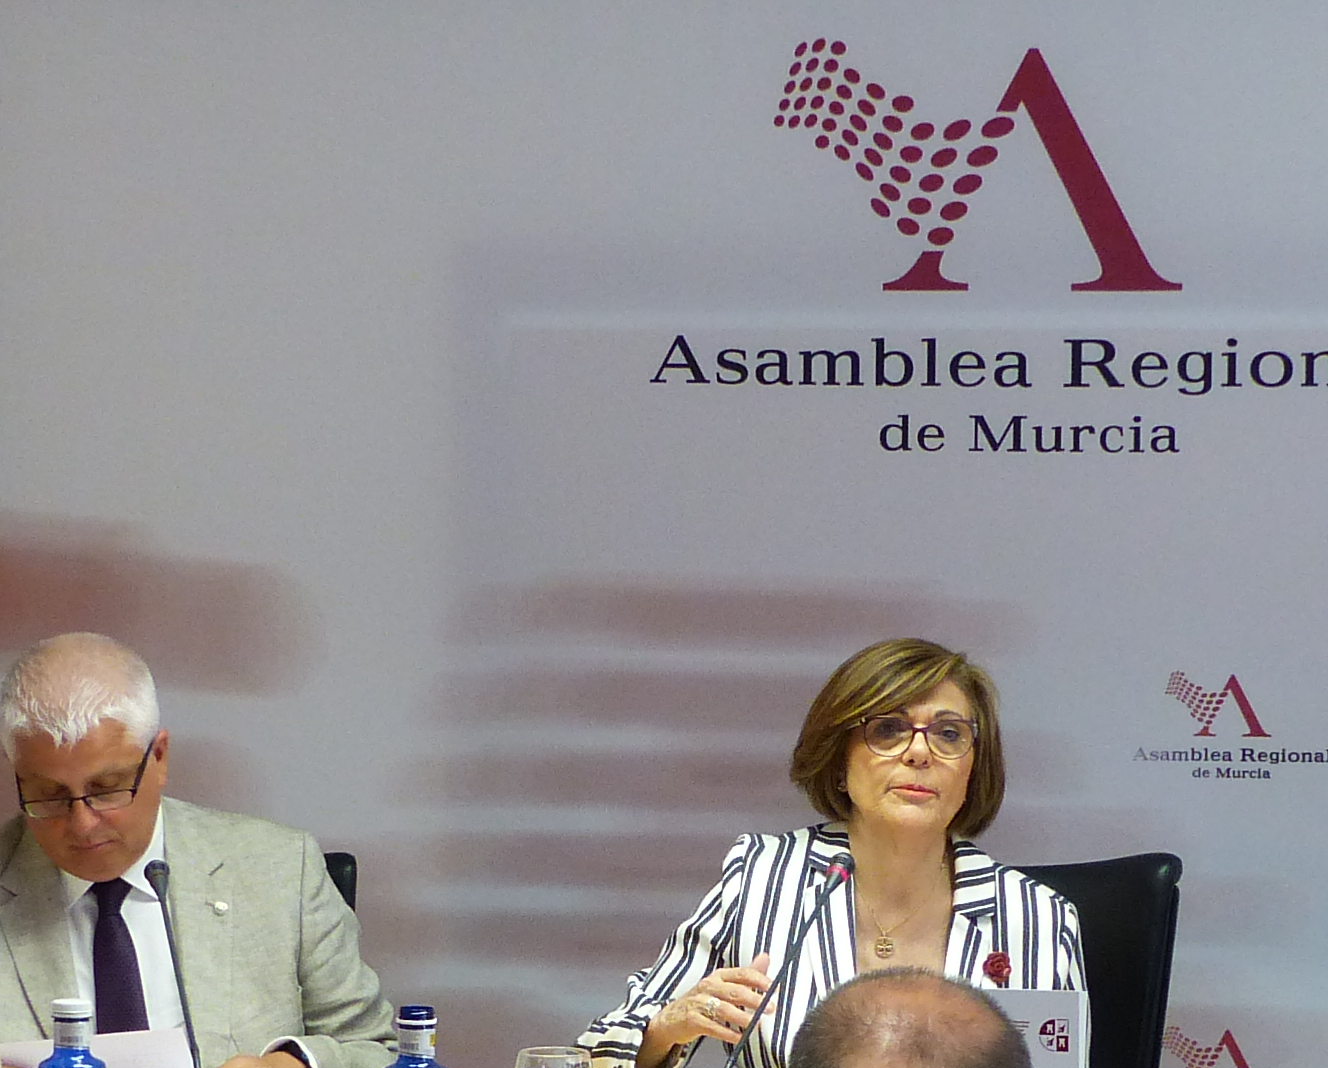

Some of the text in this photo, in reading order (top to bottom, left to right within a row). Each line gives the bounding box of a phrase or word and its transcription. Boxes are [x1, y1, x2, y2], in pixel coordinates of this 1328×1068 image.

[649, 334, 1033, 388] Asamblea
[878, 414, 1180, 454] de Murcia
[1132, 747, 1233, 763] Asamblea
[1191, 767, 1271, 779] de Murcia
